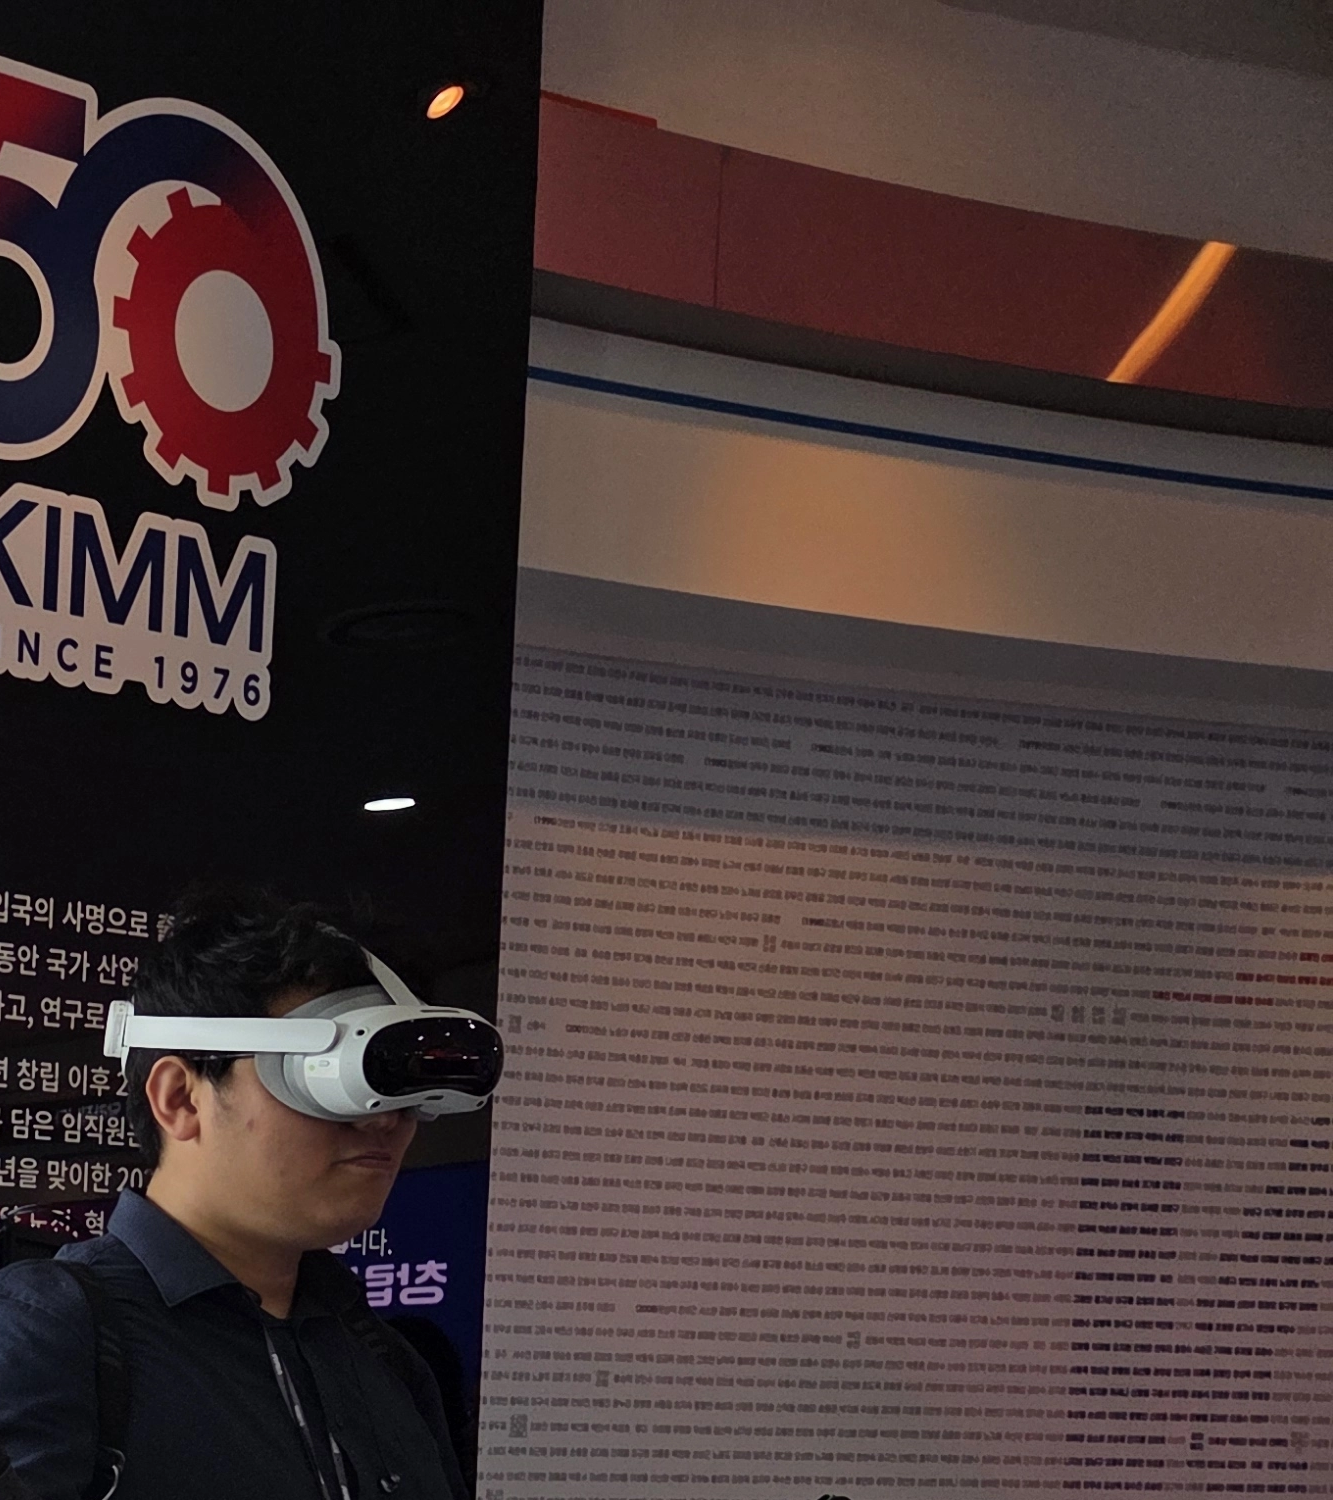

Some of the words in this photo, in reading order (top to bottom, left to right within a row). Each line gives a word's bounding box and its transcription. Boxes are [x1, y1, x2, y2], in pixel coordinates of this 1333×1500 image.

[153, 654, 263, 708] 1976
[63, 902, 150, 938] 사명으로
[47, 948, 90, 983] 국가
[41, 996, 105, 1031] 연구로
[17, 1058, 60, 1094] 창립
[68, 1064, 111, 1096] 이후
[11, 1107, 55, 1142] 담은
[47, 1159, 112, 1194] 맞이한
